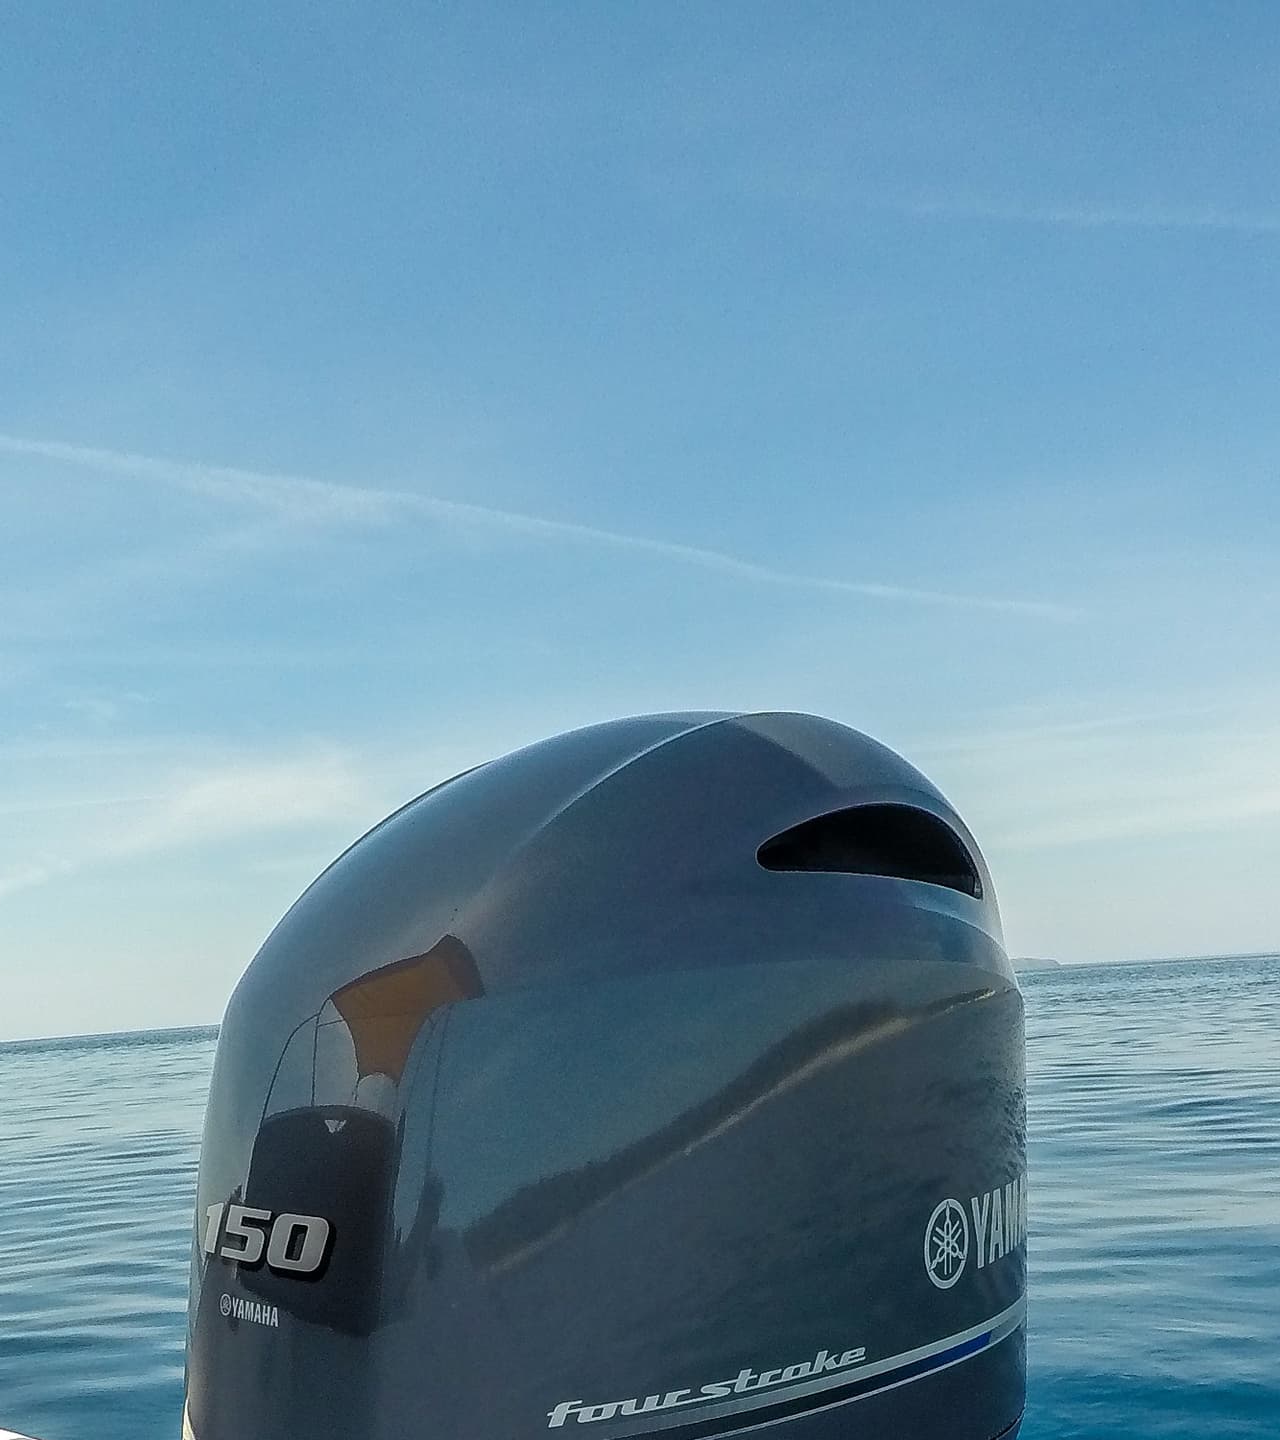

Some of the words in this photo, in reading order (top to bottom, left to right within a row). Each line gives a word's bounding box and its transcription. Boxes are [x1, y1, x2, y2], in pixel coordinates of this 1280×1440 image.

[204, 1202, 330, 1272] 150
[232, 1296, 279, 1328] YAMAHA
[547, 1388, 691, 1428] four
[700, 1347, 866, 1397] stroke
